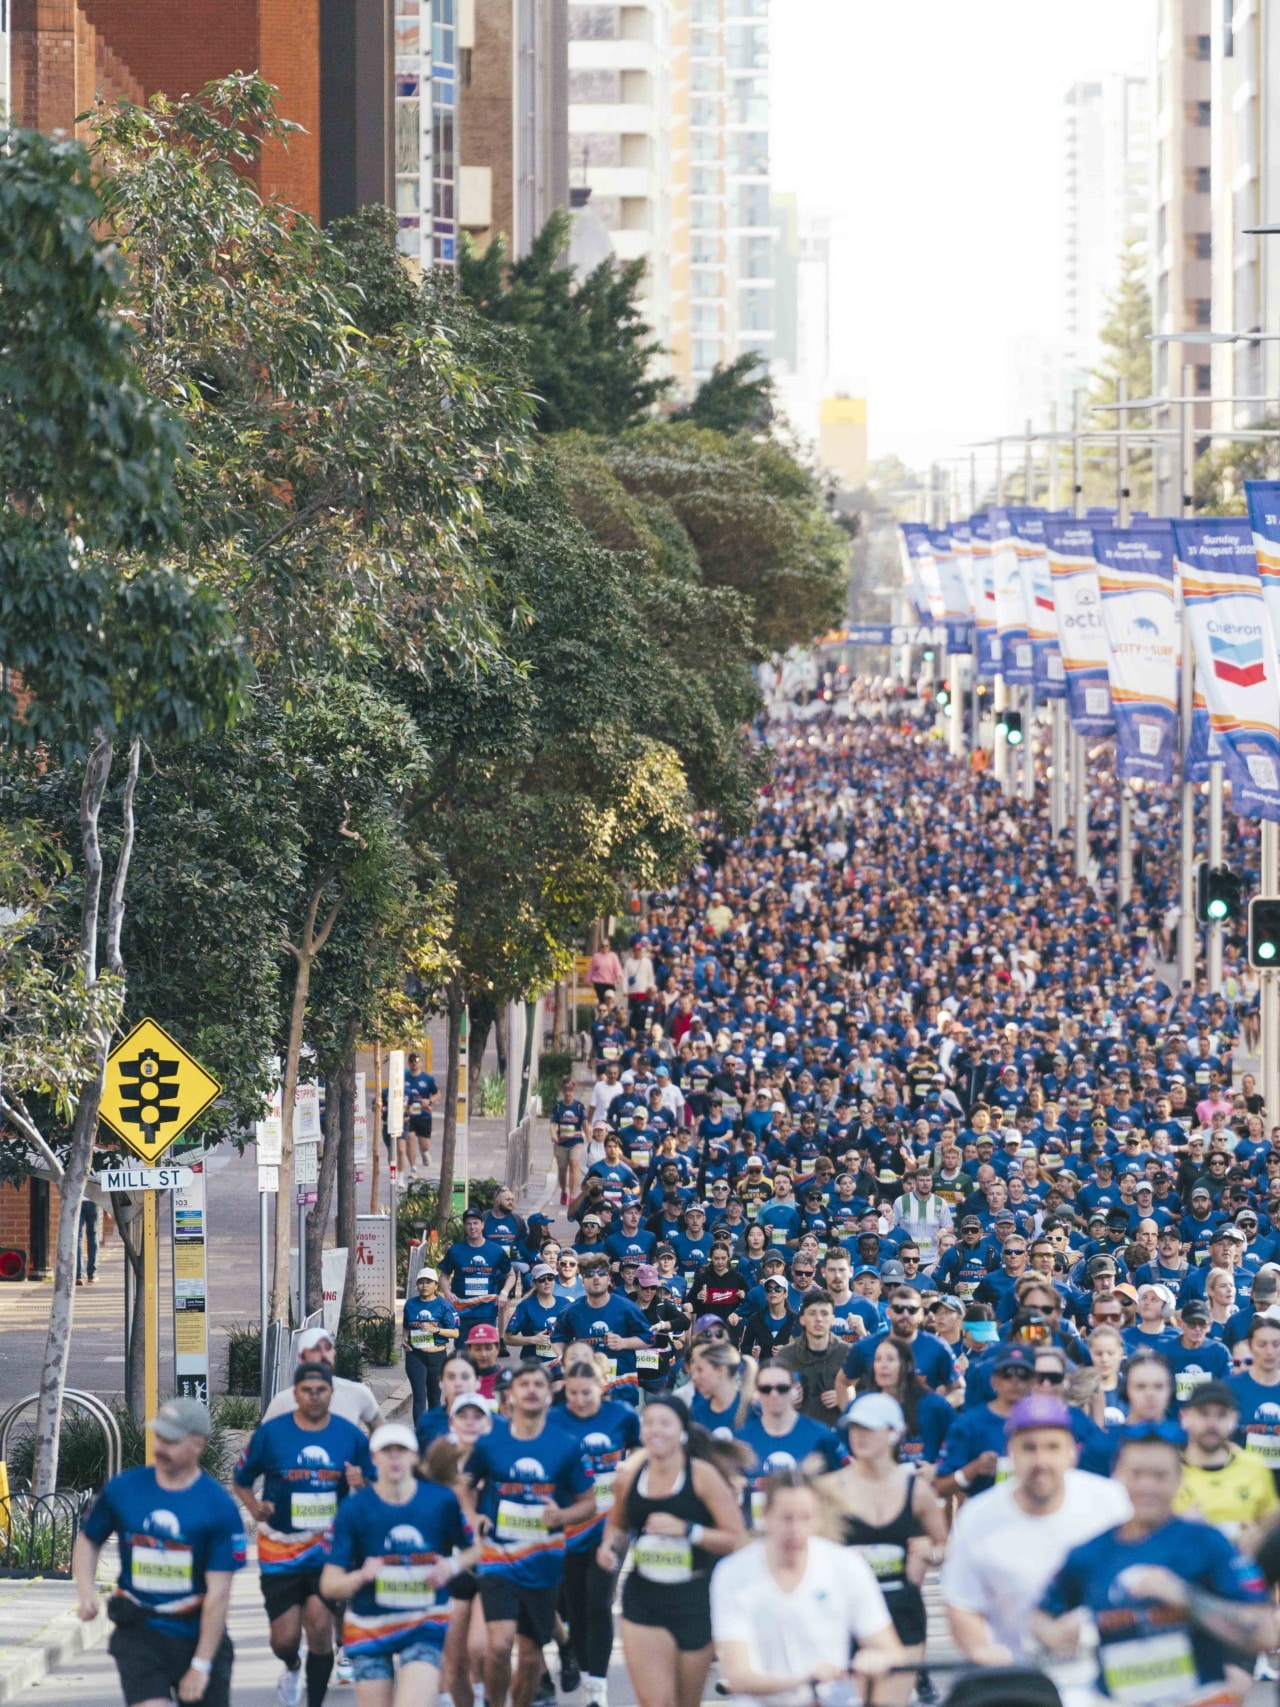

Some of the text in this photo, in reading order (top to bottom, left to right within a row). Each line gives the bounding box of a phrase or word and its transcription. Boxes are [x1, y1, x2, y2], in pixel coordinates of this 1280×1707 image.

[1264, 514, 1277, 525] 31
[1117, 541, 1148, 553] Sunday
[1203, 534, 1240, 547] Sunday
[1199, 545, 1234, 558] August
[1064, 611, 1103, 629] acti
[890, 627, 949, 646] STAR
[1119, 643, 1142, 654] CITY
[107, 1168, 181, 1189] MILL ST
